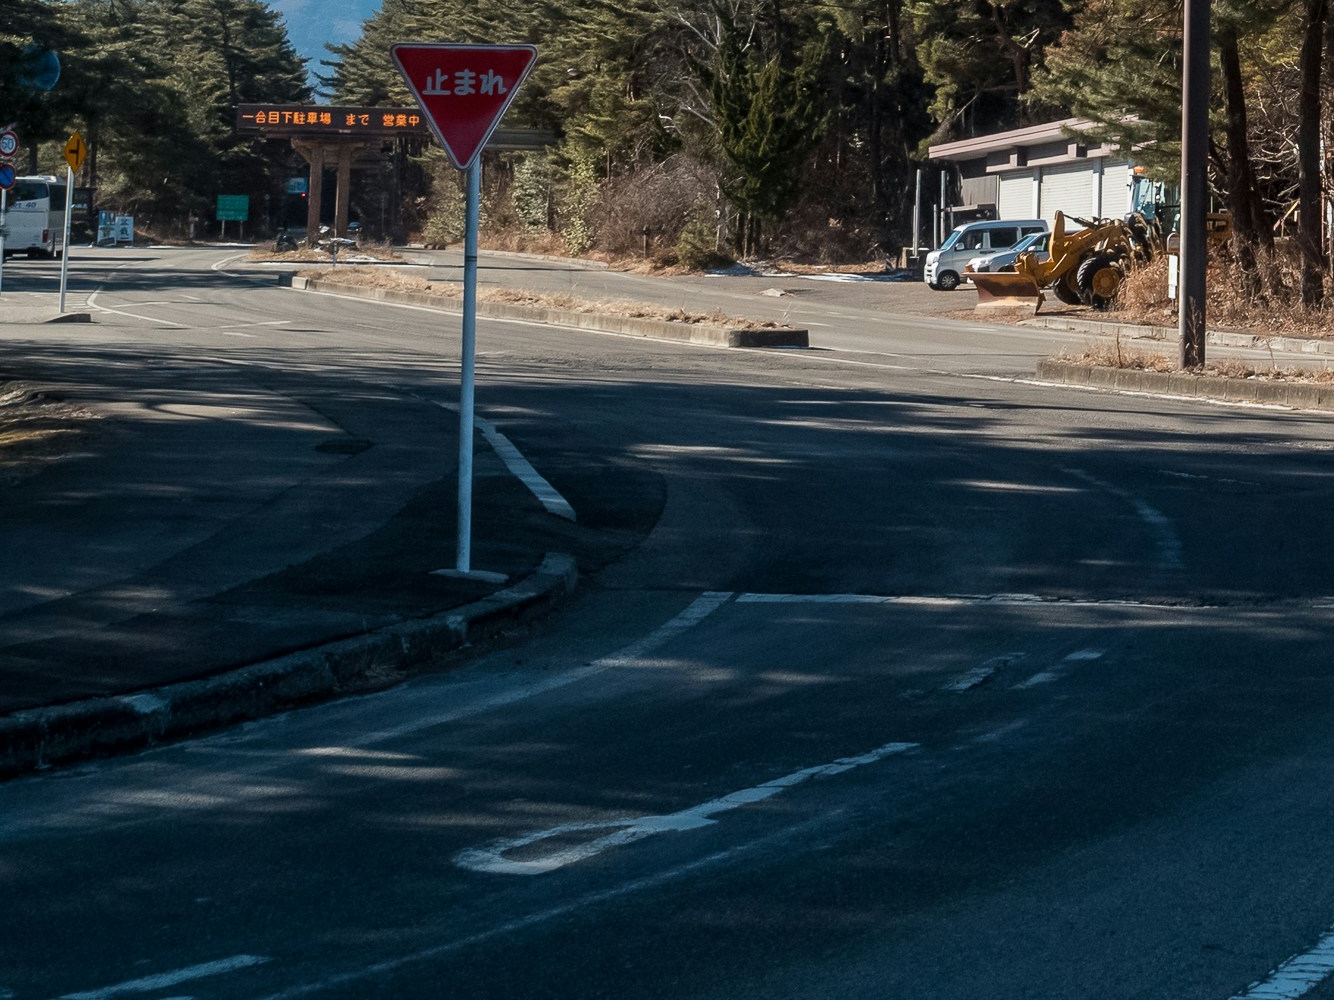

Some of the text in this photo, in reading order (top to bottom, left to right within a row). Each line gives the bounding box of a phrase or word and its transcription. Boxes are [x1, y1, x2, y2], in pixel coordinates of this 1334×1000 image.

[422, 68, 507, 96] 止まれ
[242, 110, 420, 127] 一合目下駐車場 まで 営業中
